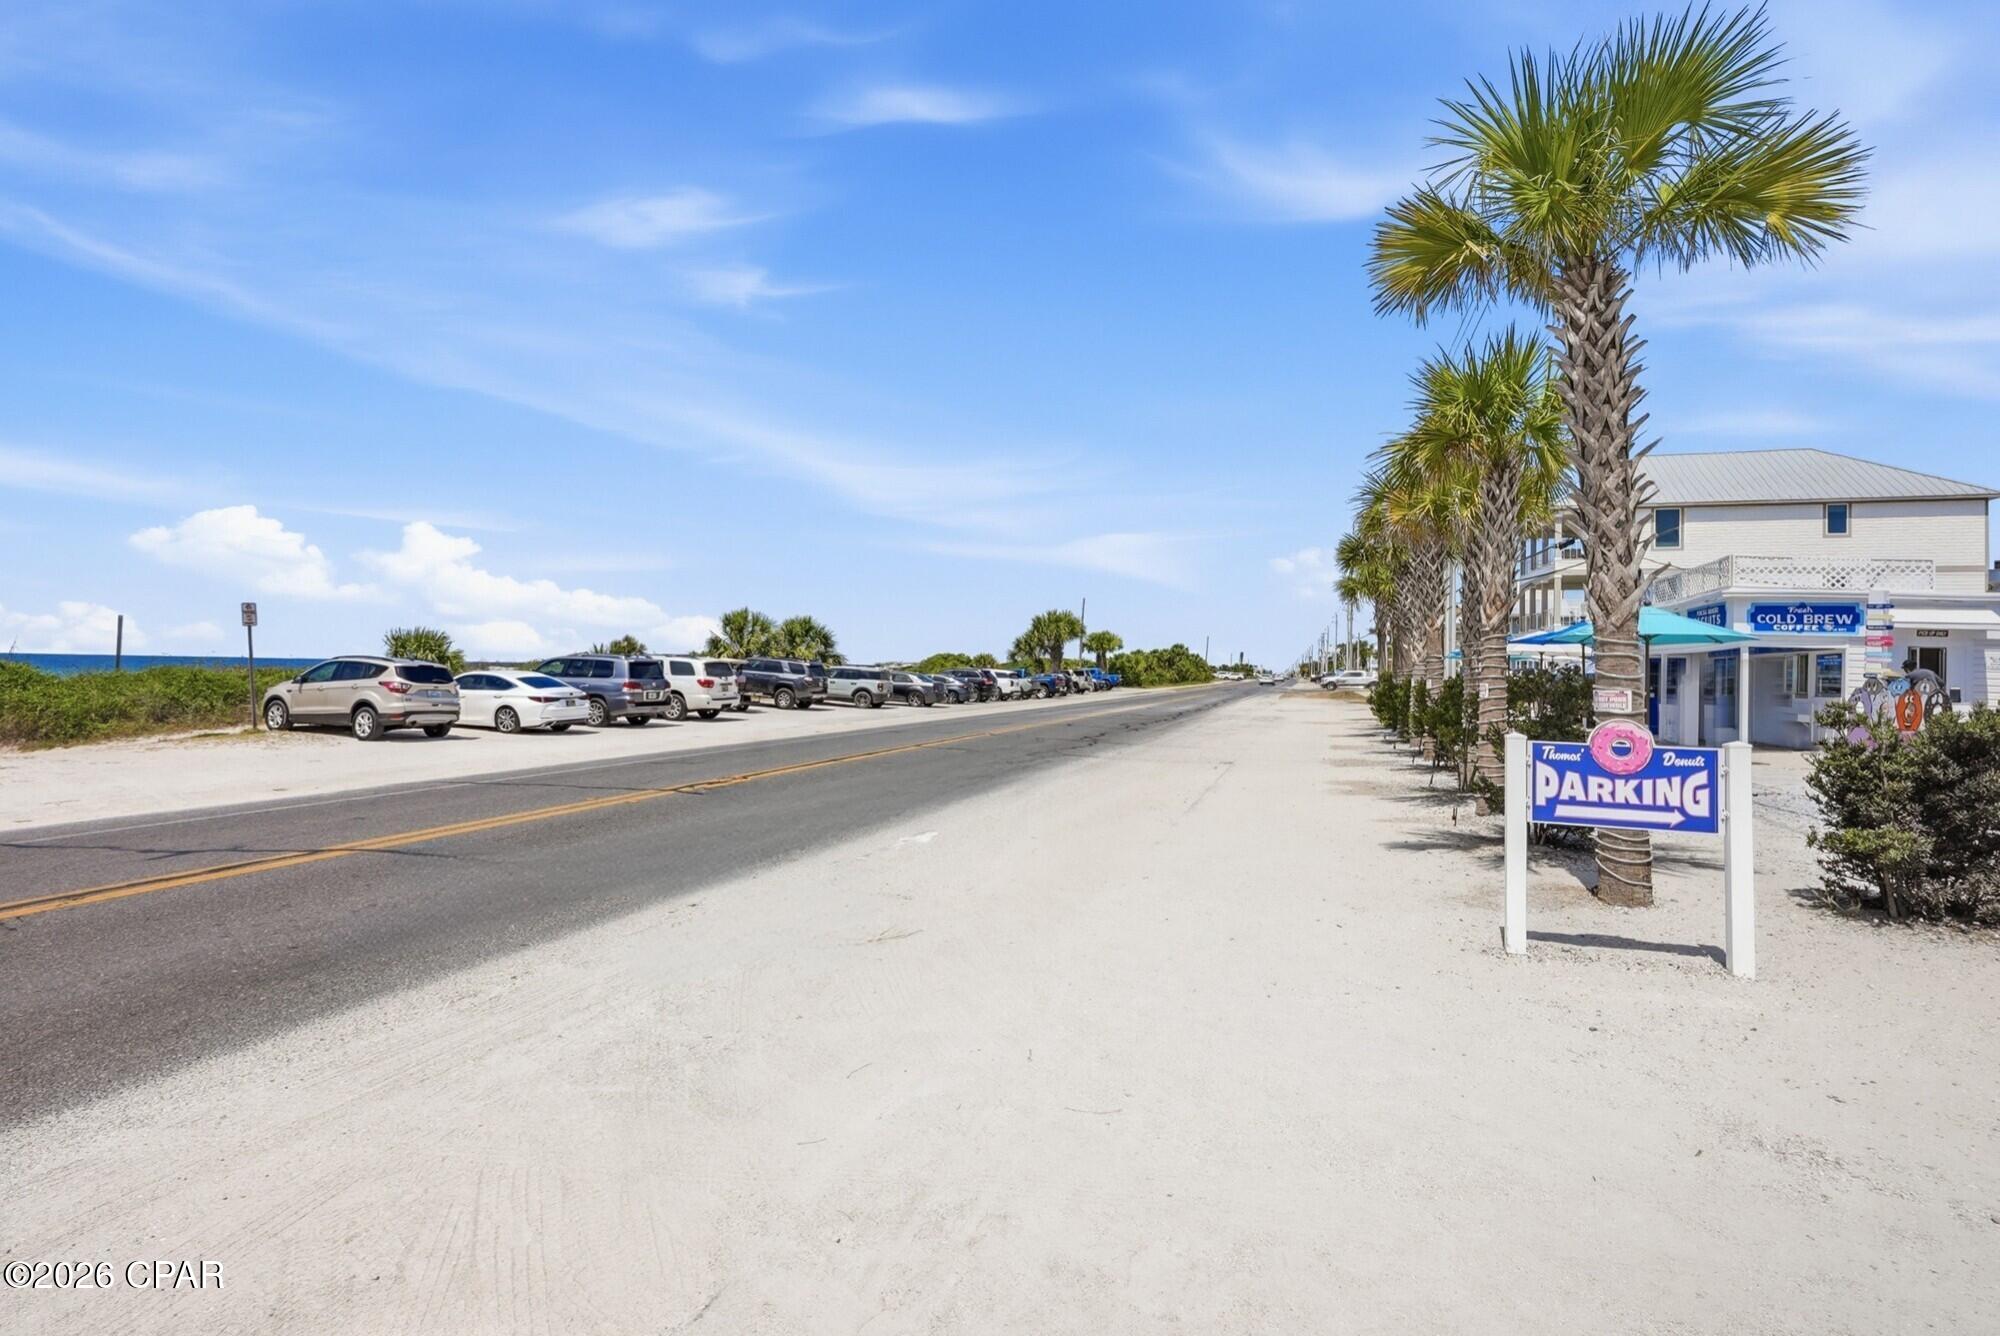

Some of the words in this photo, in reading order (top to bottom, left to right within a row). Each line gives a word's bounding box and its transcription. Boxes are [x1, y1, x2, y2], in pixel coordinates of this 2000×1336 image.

[1757, 614, 1797, 625] COLD
[1803, 614, 1853, 625] BREW
[1542, 745, 1584, 761] Thomas'
[1662, 752, 1705, 767] Donuts
[1536, 760, 1710, 817] PARKING
